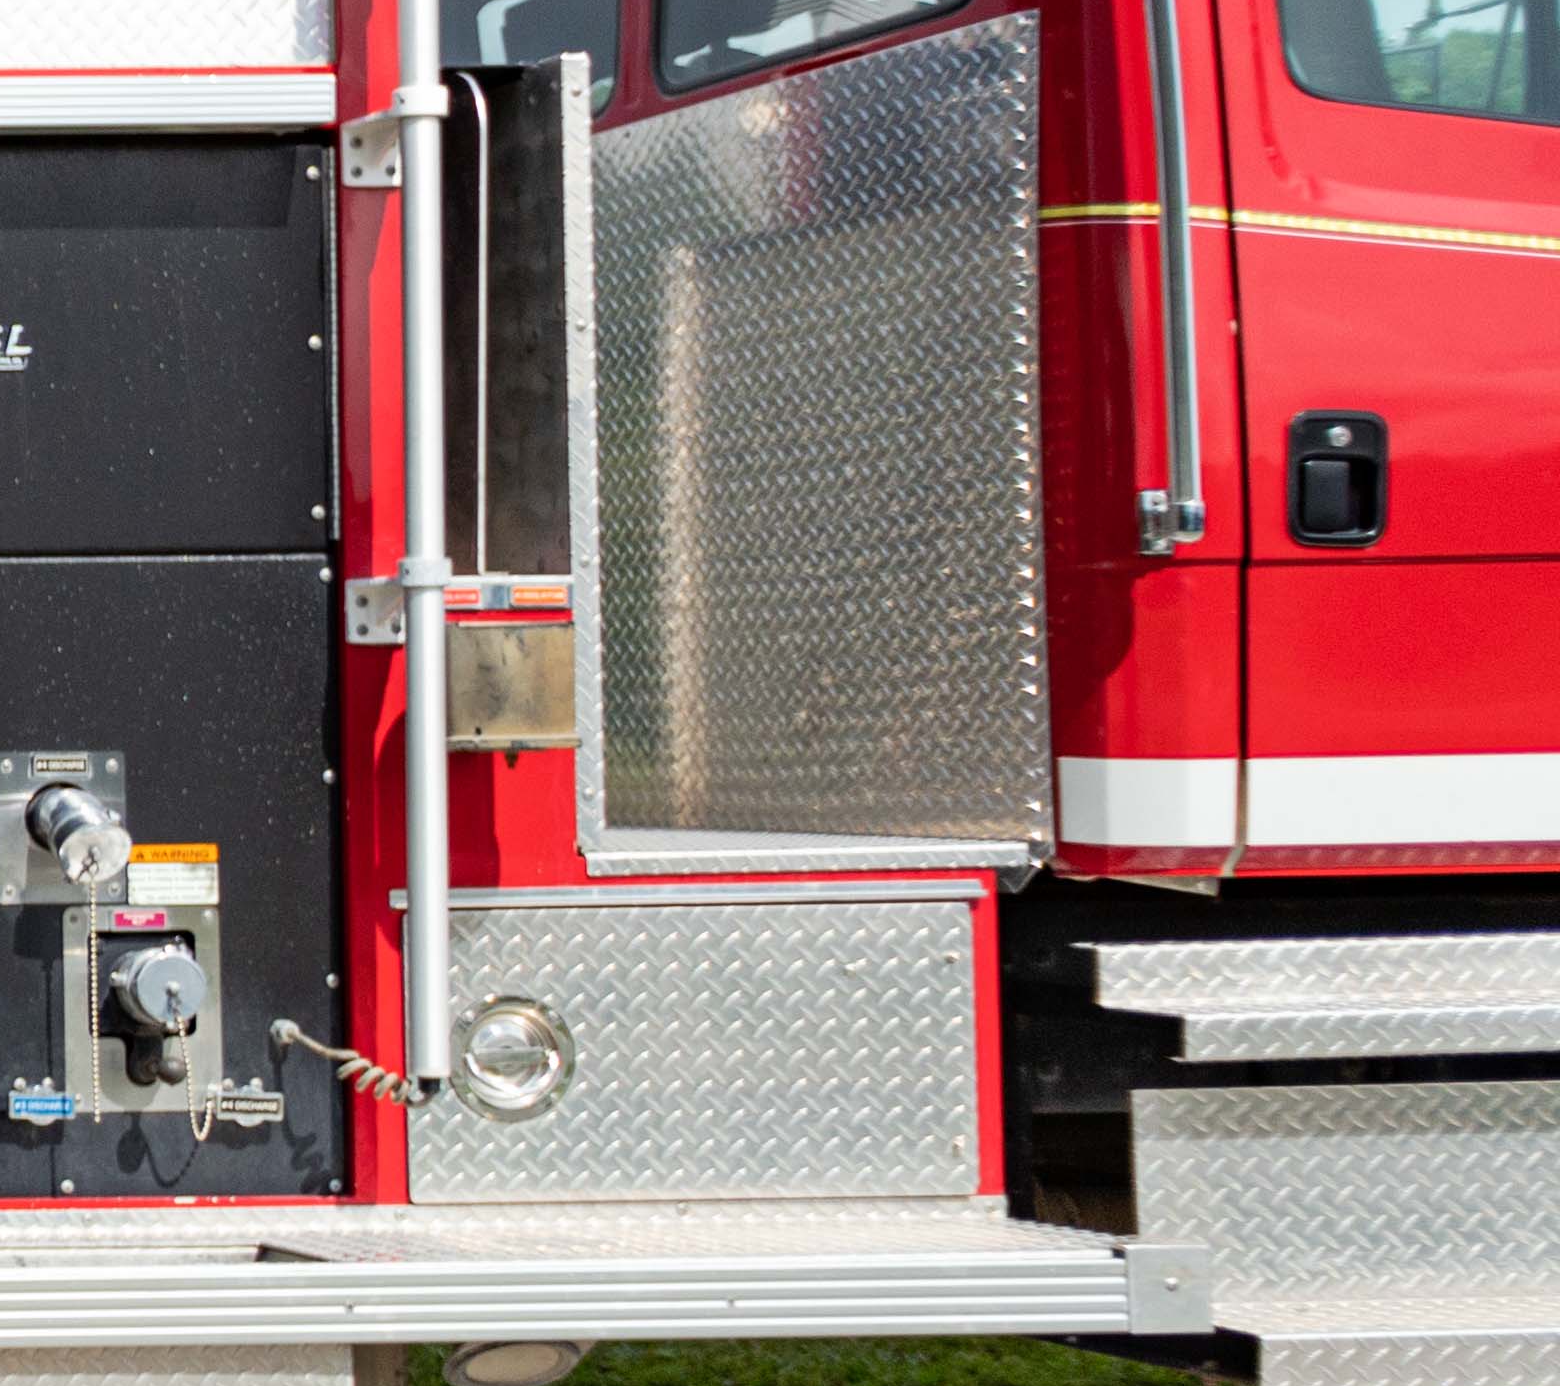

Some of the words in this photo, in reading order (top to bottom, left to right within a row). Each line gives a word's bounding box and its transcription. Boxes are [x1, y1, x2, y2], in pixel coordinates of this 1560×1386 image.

[150, 850, 210, 860] WARNING
[27, 1101, 71, 1112] DISCHARE
[234, 1100, 278, 1112] DISCHARGE
